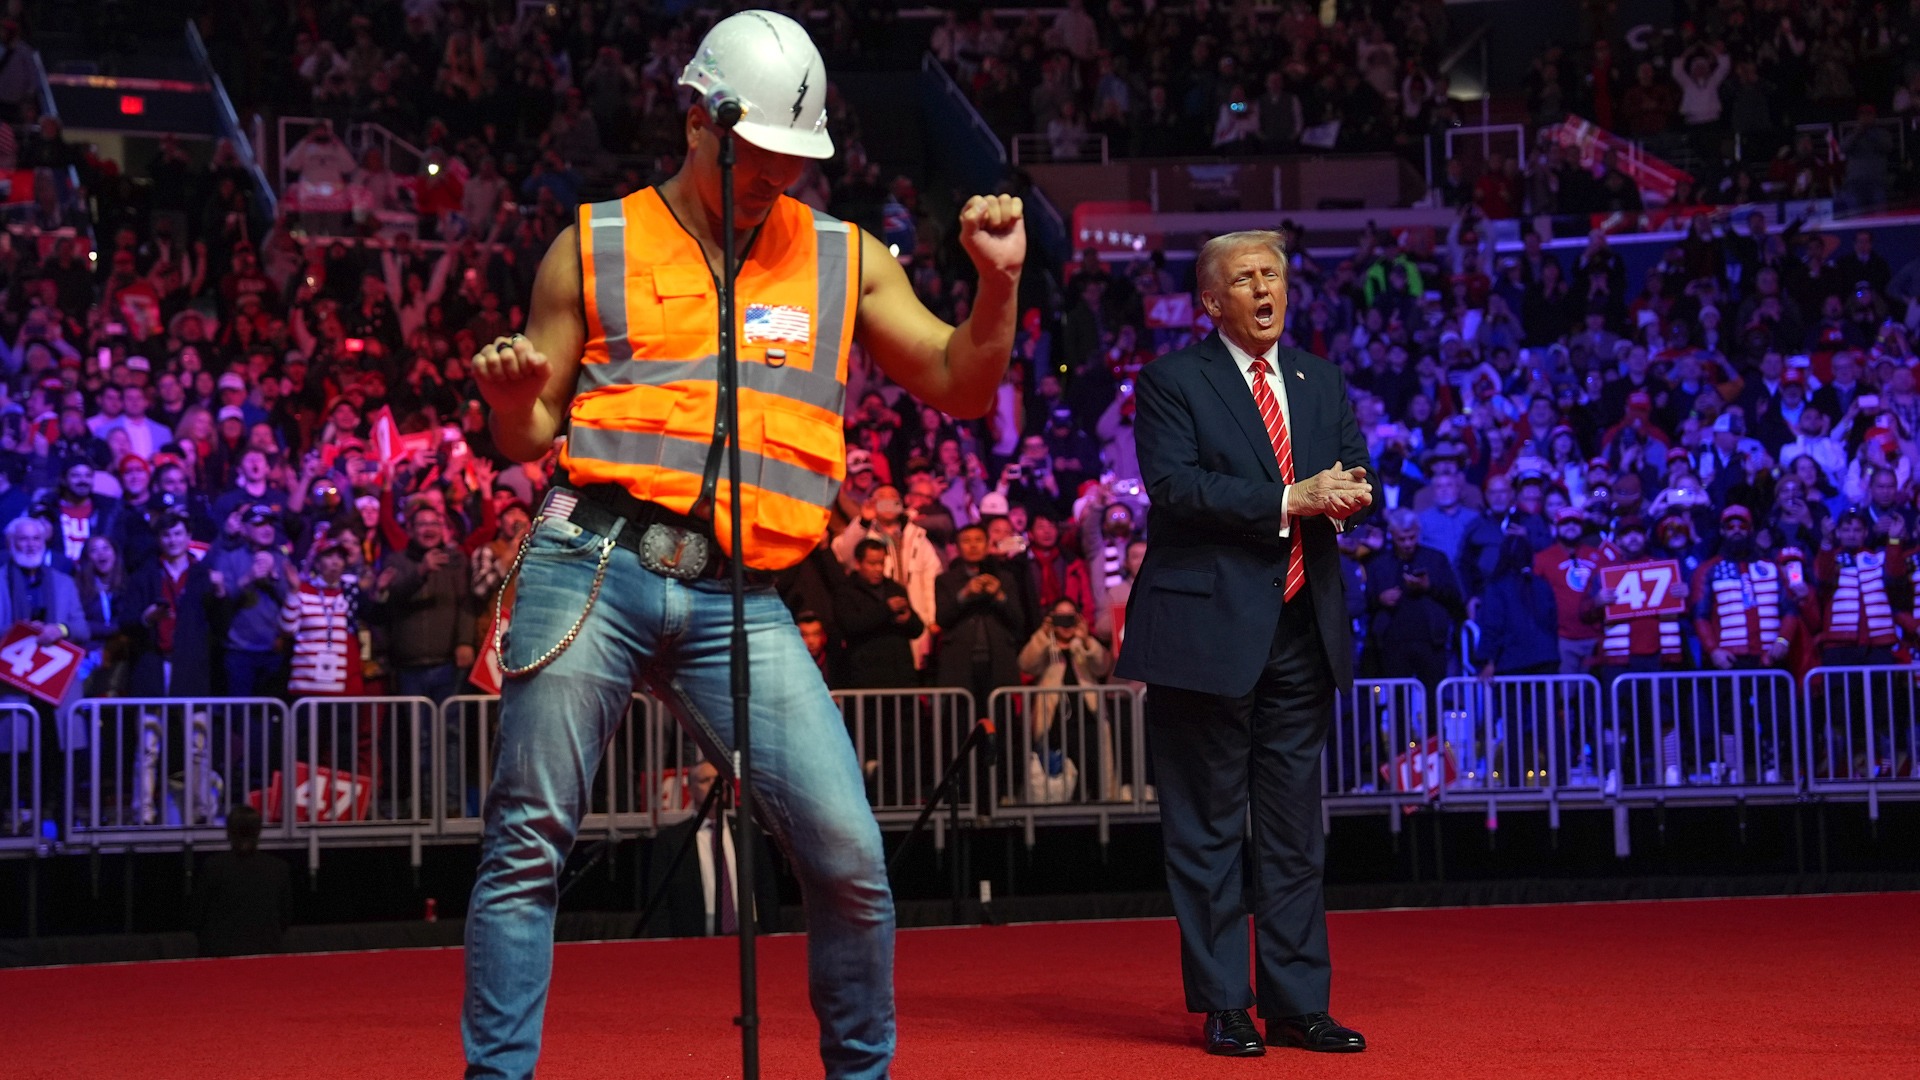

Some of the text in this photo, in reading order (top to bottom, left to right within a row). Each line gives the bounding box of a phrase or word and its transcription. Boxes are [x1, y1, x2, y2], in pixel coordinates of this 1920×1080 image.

[1151, 299, 1185, 322] 47
[1615, 567, 1672, 610] 47
[0, 635, 74, 685] 47
[293, 774, 362, 819] 47
